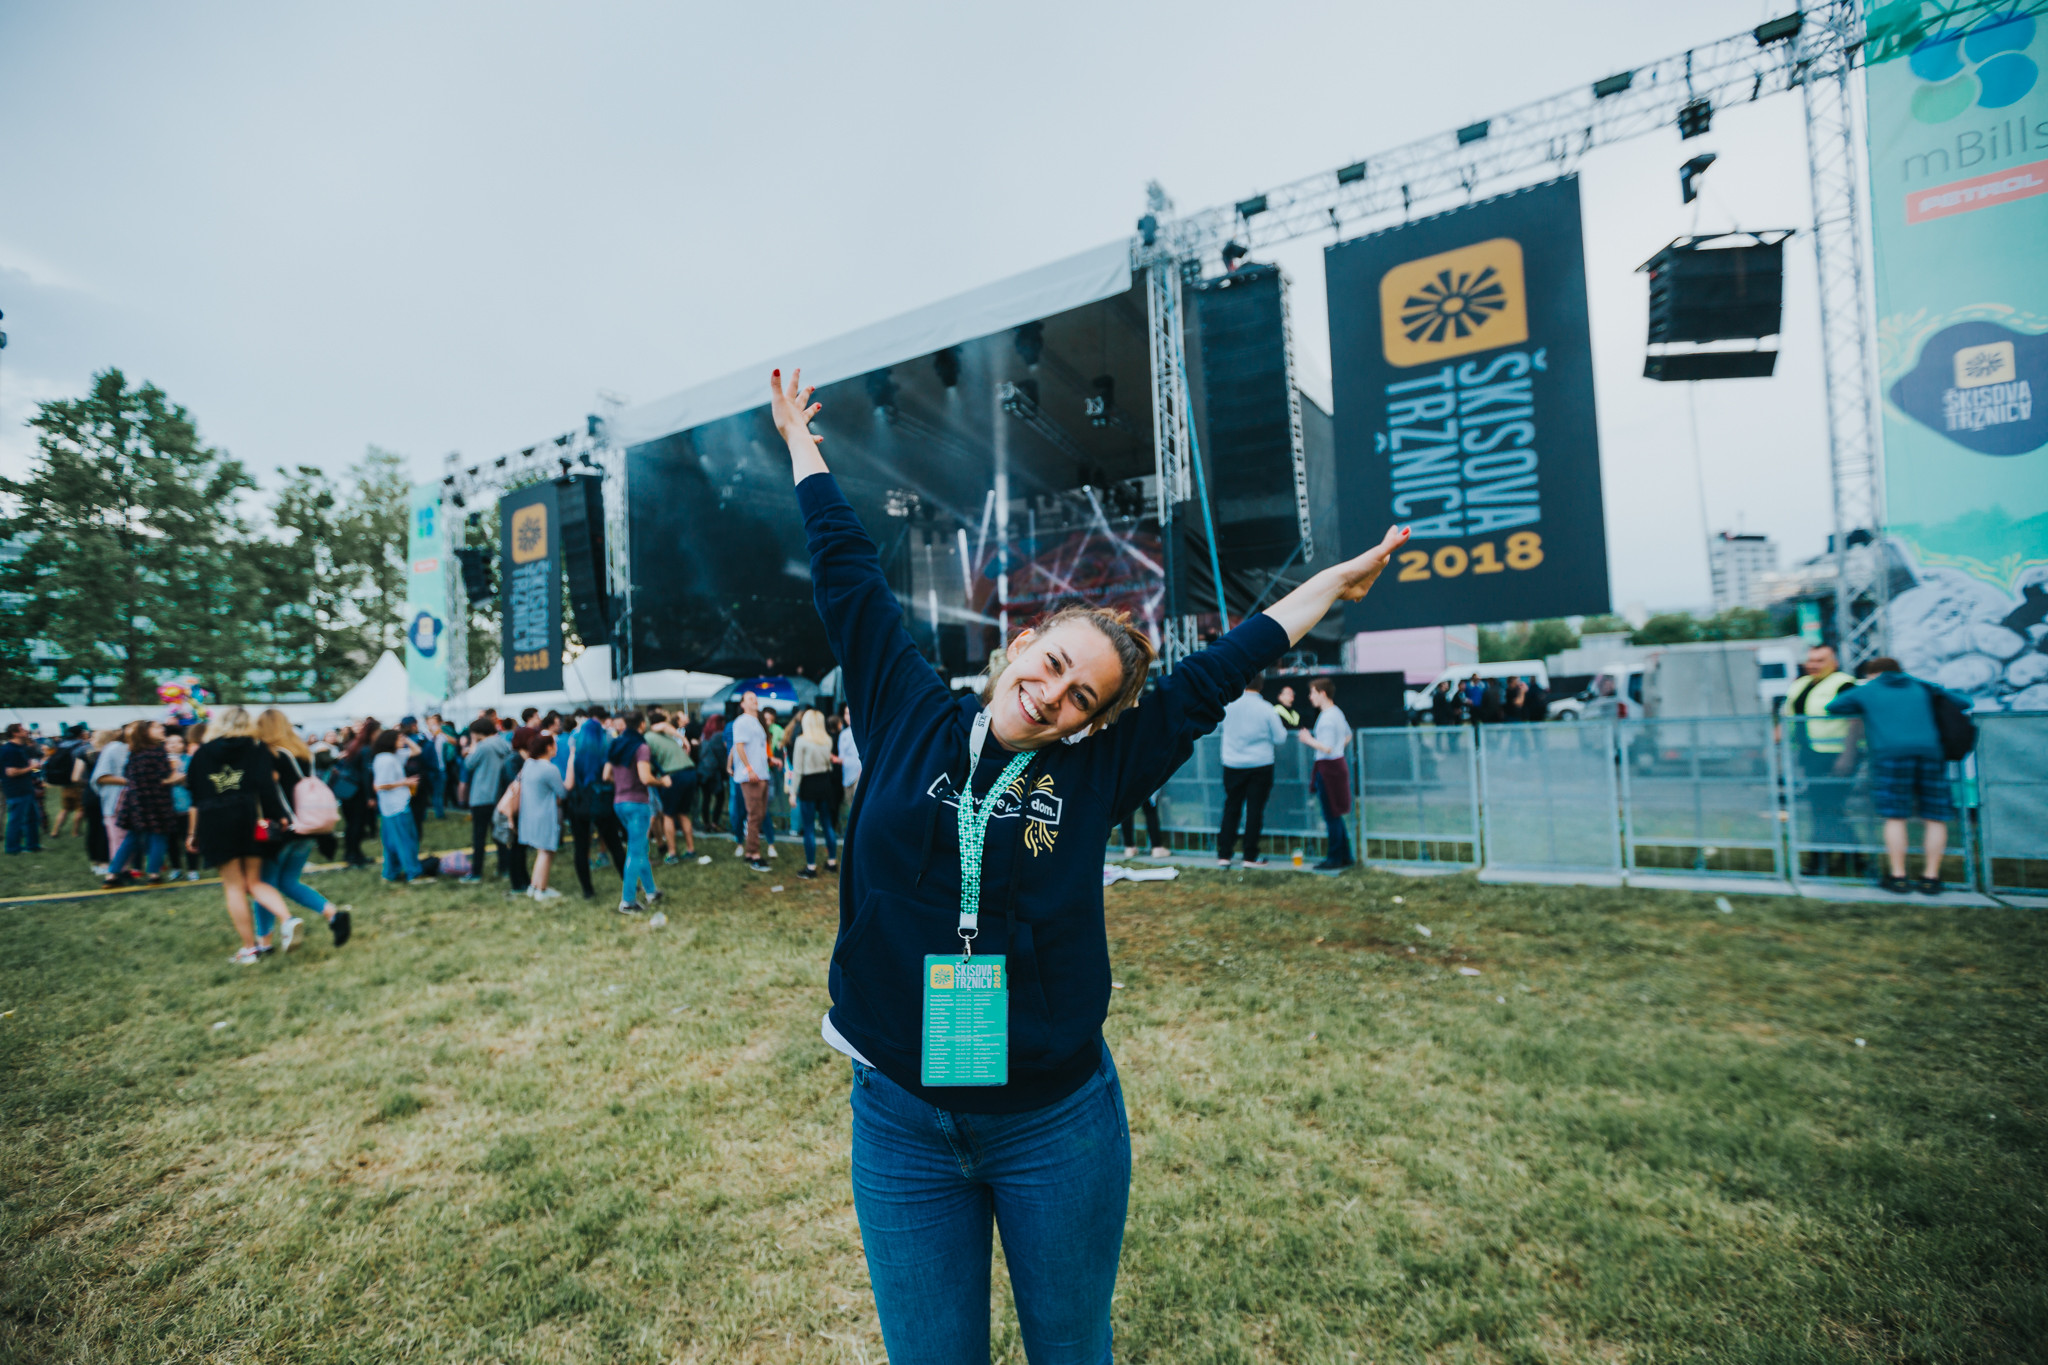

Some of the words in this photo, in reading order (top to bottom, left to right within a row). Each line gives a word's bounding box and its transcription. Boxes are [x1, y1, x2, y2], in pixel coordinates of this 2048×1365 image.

[1903, 115, 2048, 182] mBills
[1374, 366, 1464, 540] TRŽNICA
[1457, 347, 1547, 536] ŠKISOVA
[1397, 531, 1545, 582] 2018
[514, 650, 550, 673] 2018
[1030, 798, 1057, 817] dom.
[955, 962, 993, 977] ŠKISOVA
[992, 964, 1002, 989] 2018
[955, 976, 993, 992] TRŽNICA
